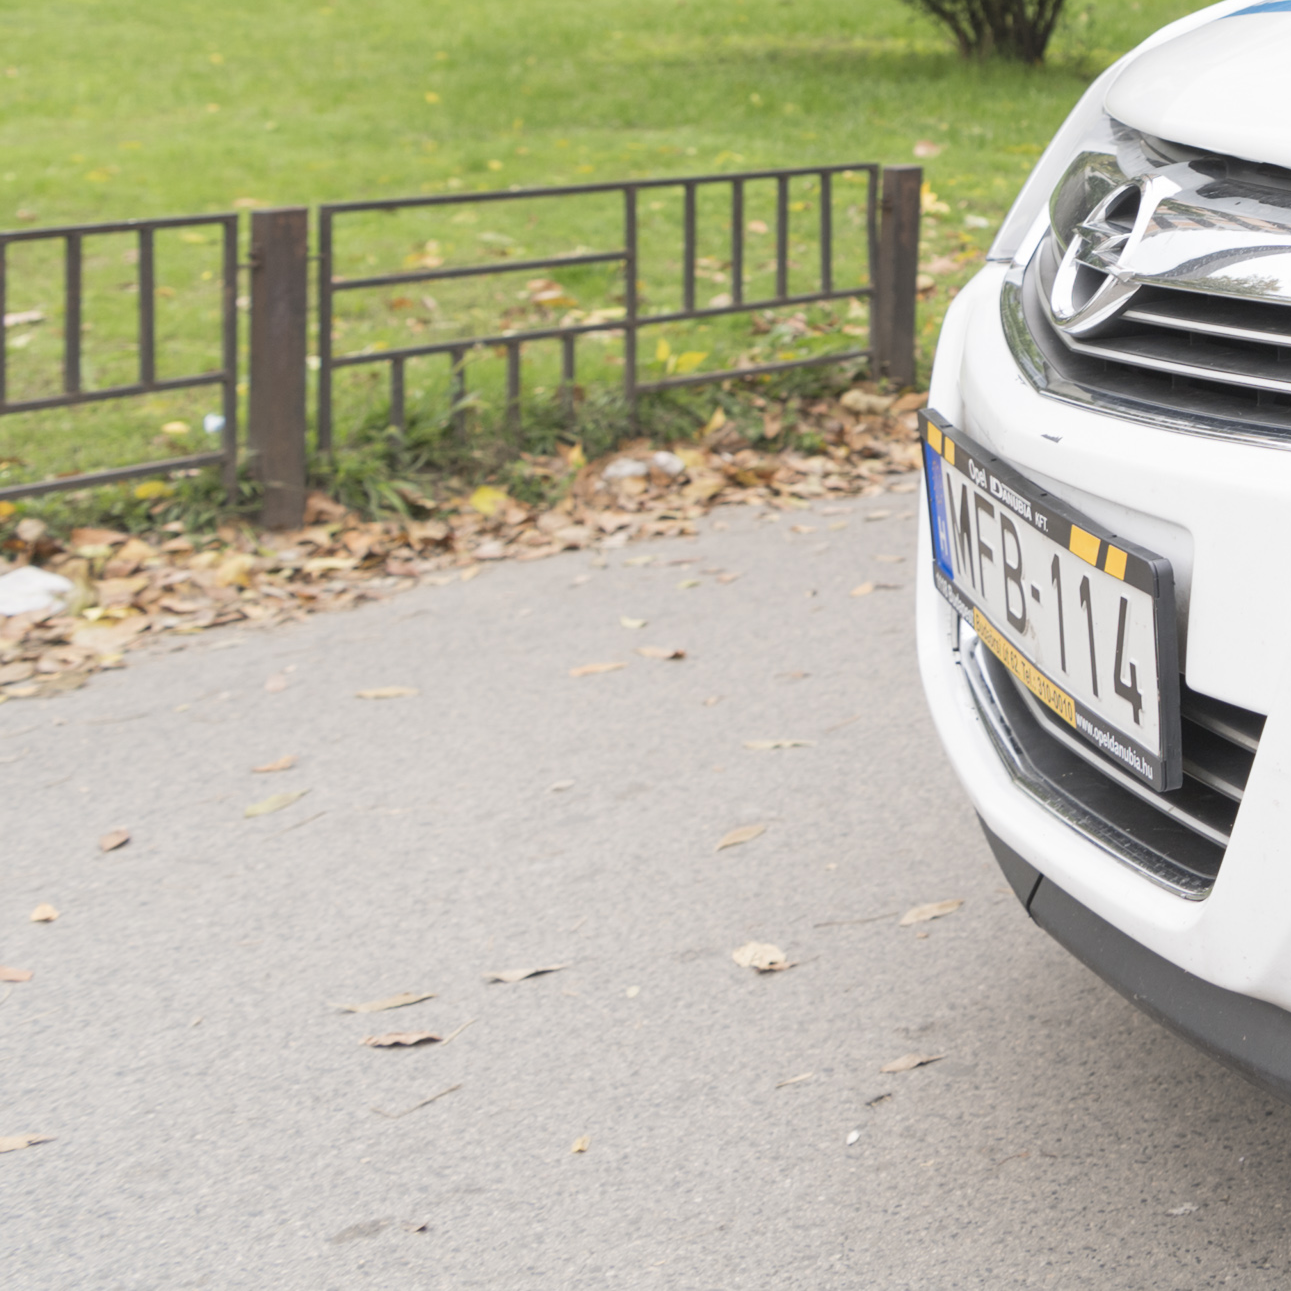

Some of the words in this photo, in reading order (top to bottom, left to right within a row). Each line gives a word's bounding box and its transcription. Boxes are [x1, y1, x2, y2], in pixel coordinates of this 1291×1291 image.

[968, 458, 988, 489] Opel
[945, 471, 1143, 727] MFB-114
[1037, 676, 1073, 722] 310-0010
[1075, 711, 1154, 781] www.opeldanubia.hu
